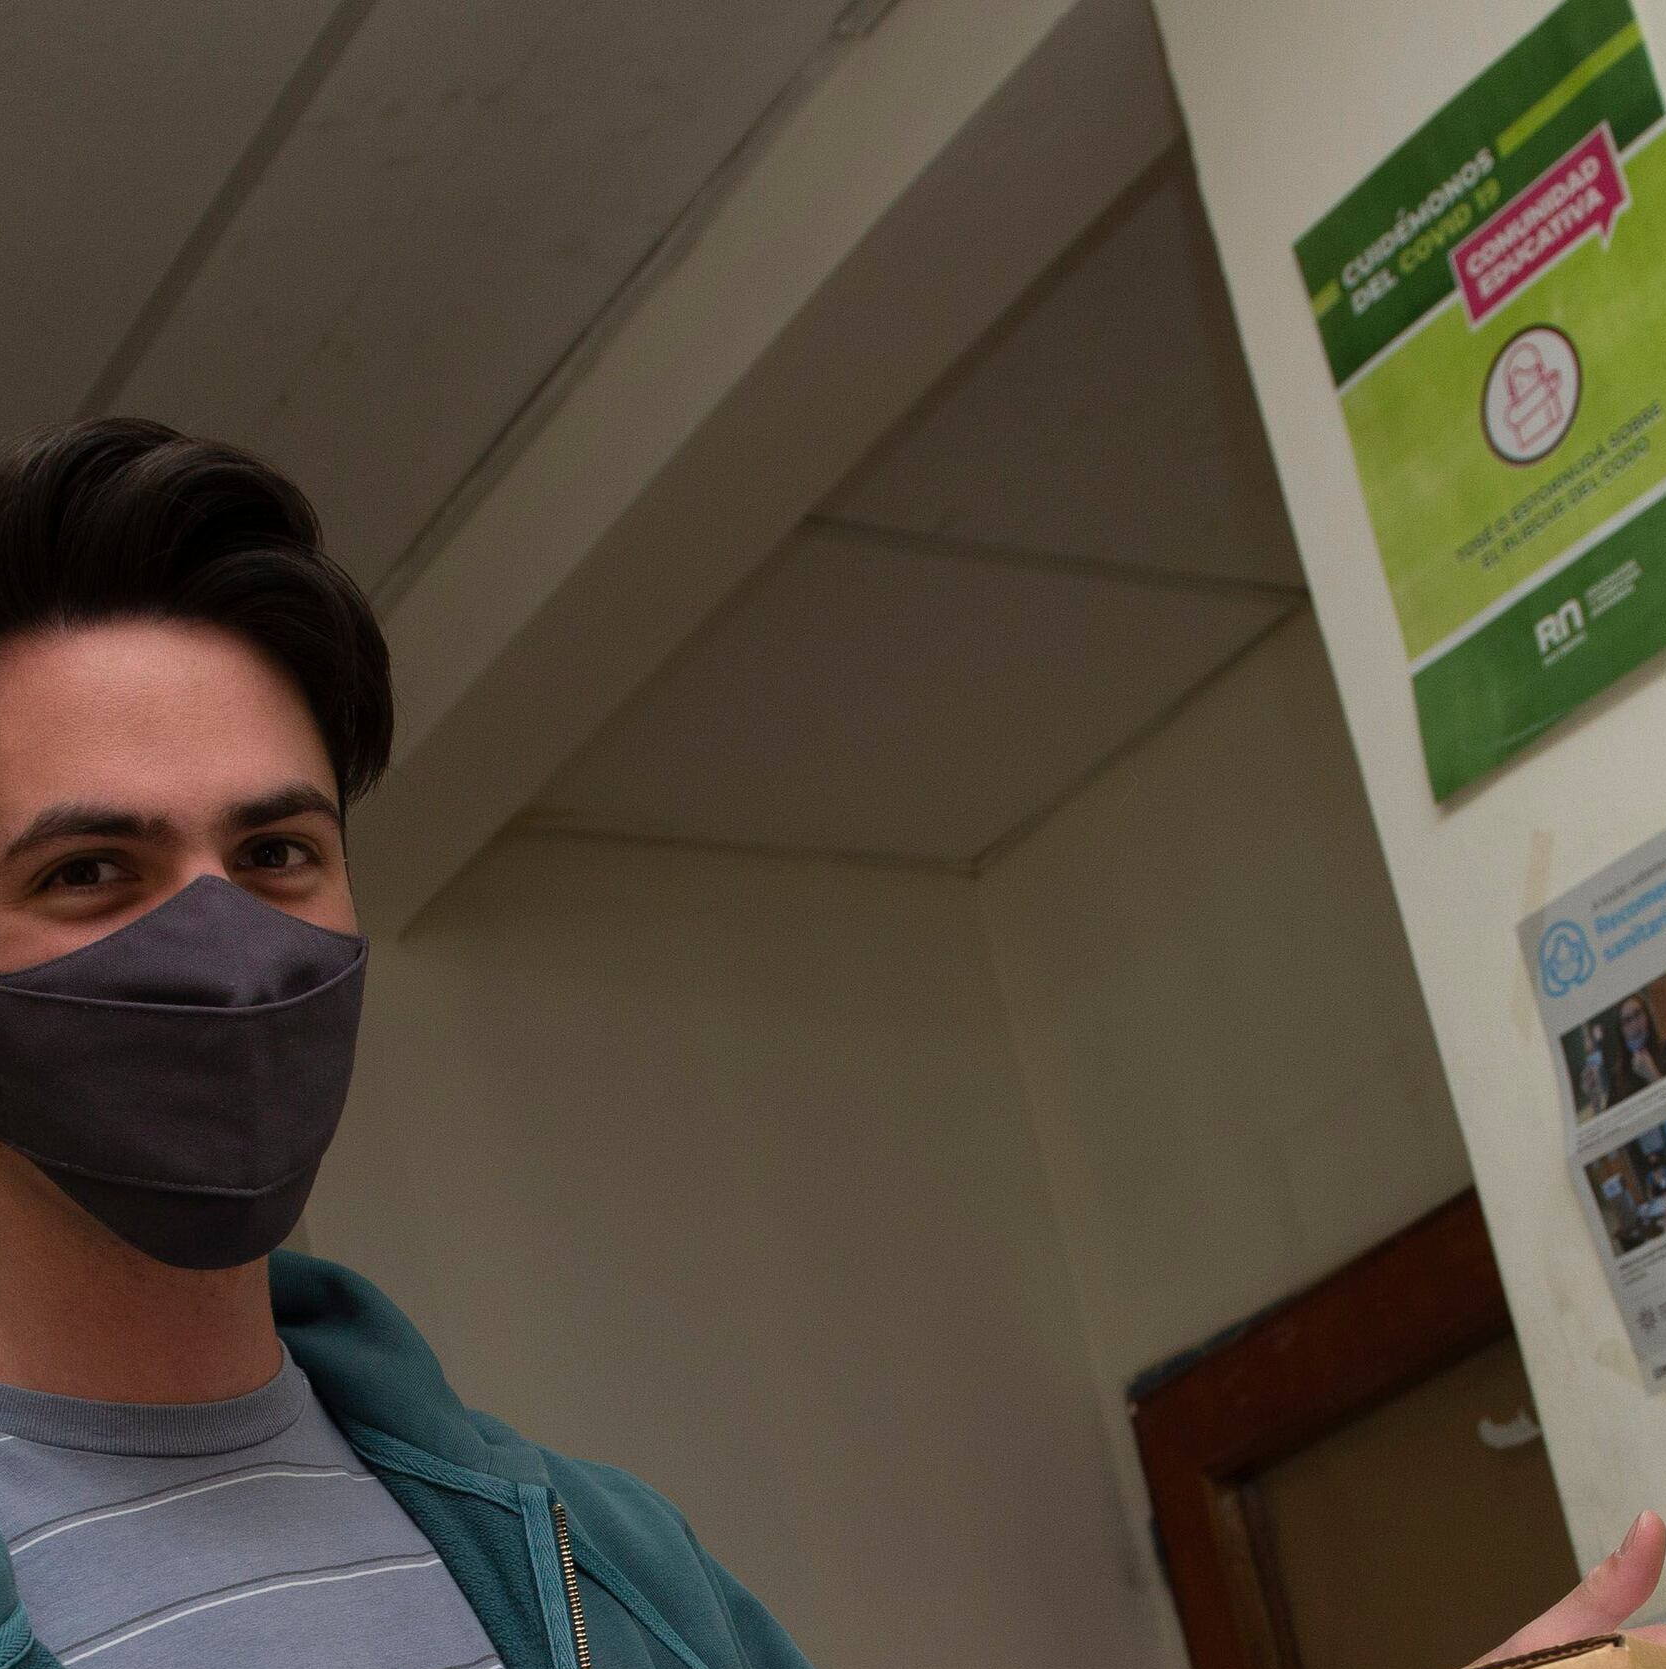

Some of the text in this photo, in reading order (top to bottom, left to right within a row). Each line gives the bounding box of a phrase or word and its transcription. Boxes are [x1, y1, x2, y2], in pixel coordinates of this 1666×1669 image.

[1341, 147, 1496, 288] CUIDÉMONOS
[1349, 268, 1399, 317] DEL
[1398, 202, 1473, 275] COVID
[1465, 155, 1601, 278] COMUNIDAD
[1475, 185, 1605, 299] EDUCATIVA
